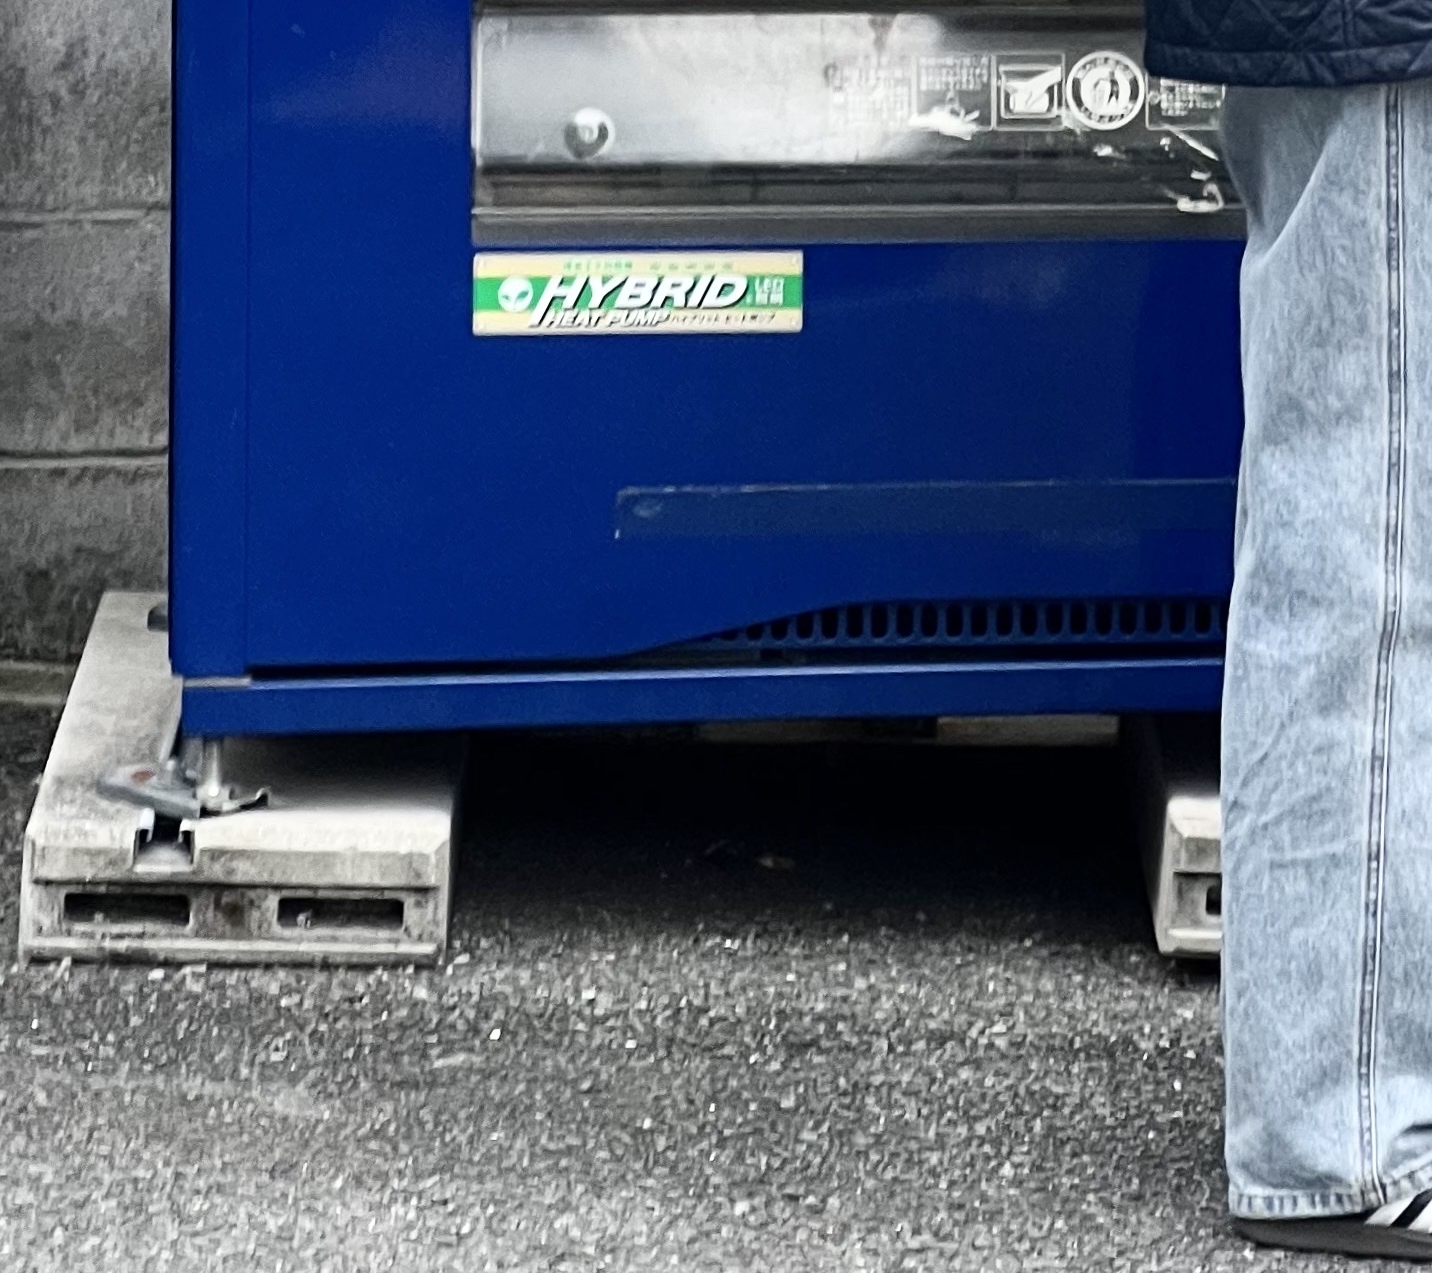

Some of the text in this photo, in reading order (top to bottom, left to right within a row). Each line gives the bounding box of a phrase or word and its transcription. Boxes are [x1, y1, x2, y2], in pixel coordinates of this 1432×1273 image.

[530, 273, 749, 325] HYBRID
[547, 309, 672, 328] HEAT PUMP
